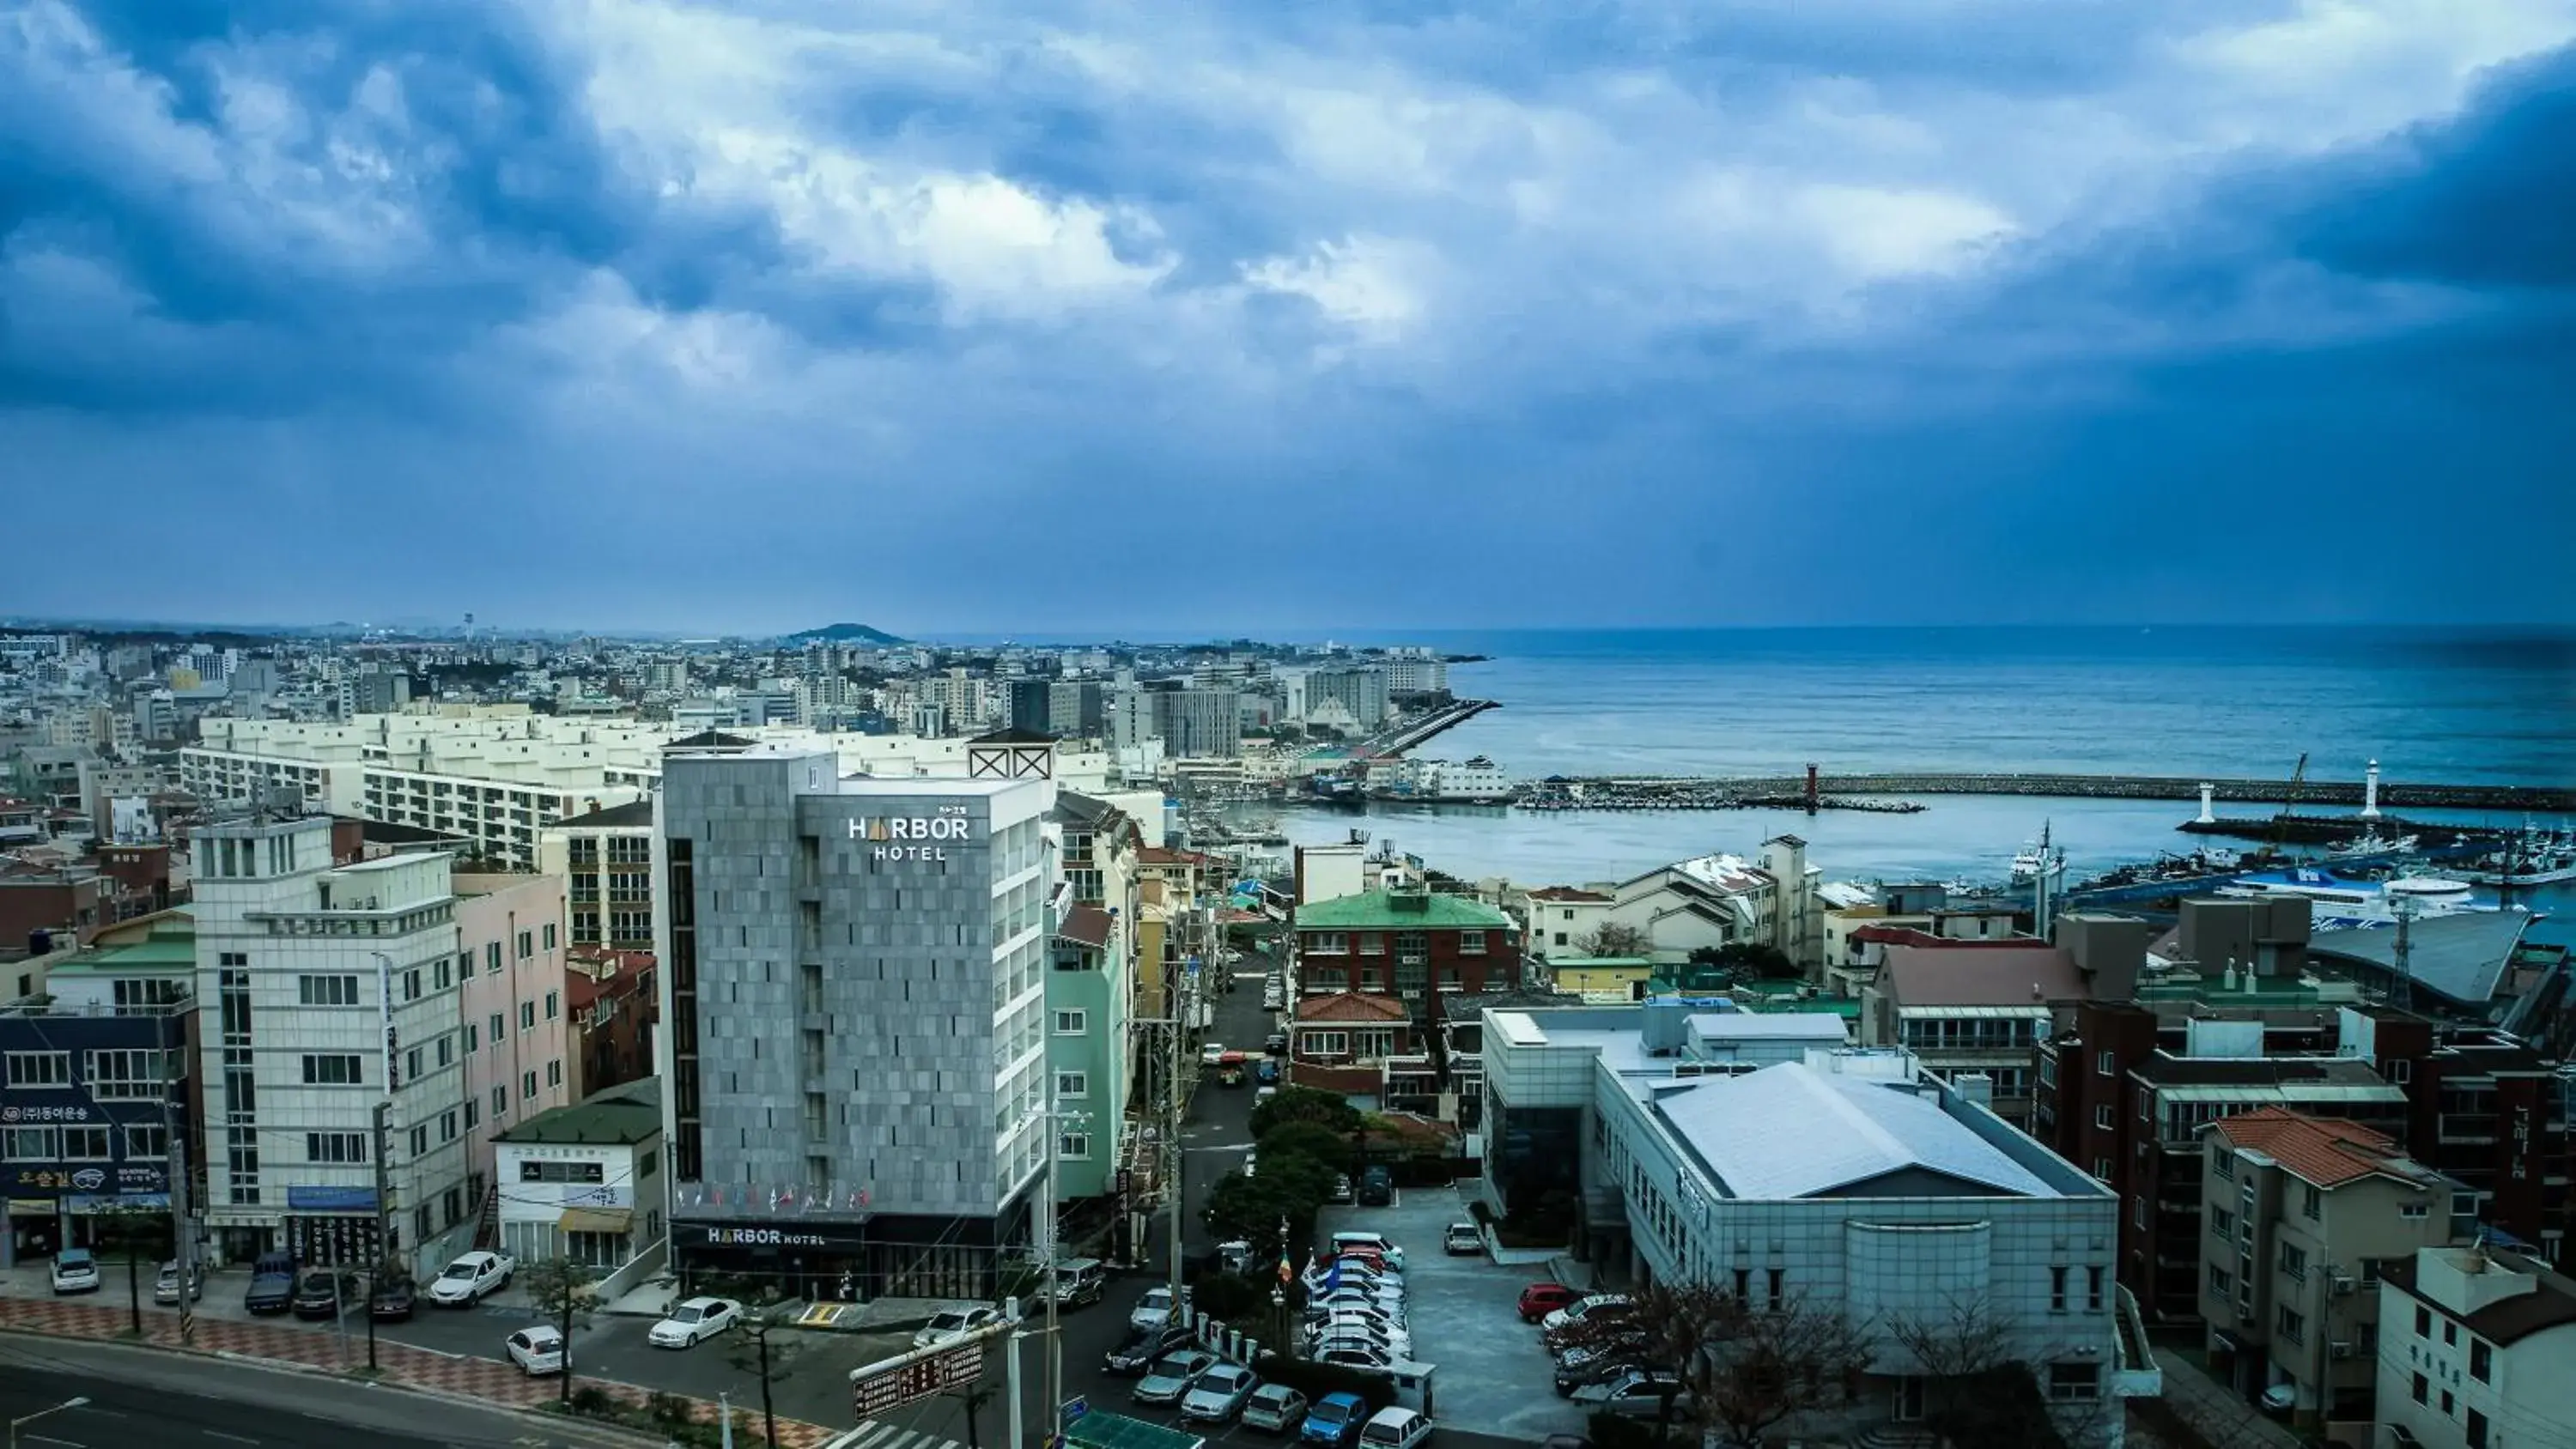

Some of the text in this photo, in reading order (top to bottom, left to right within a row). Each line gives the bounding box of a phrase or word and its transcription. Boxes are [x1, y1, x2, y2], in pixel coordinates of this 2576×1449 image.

[848, 817, 969, 840] HARBOR
[875, 846, 945, 861] HOTEL
[708, 1228, 825, 1246] HARBOR HOTEL
